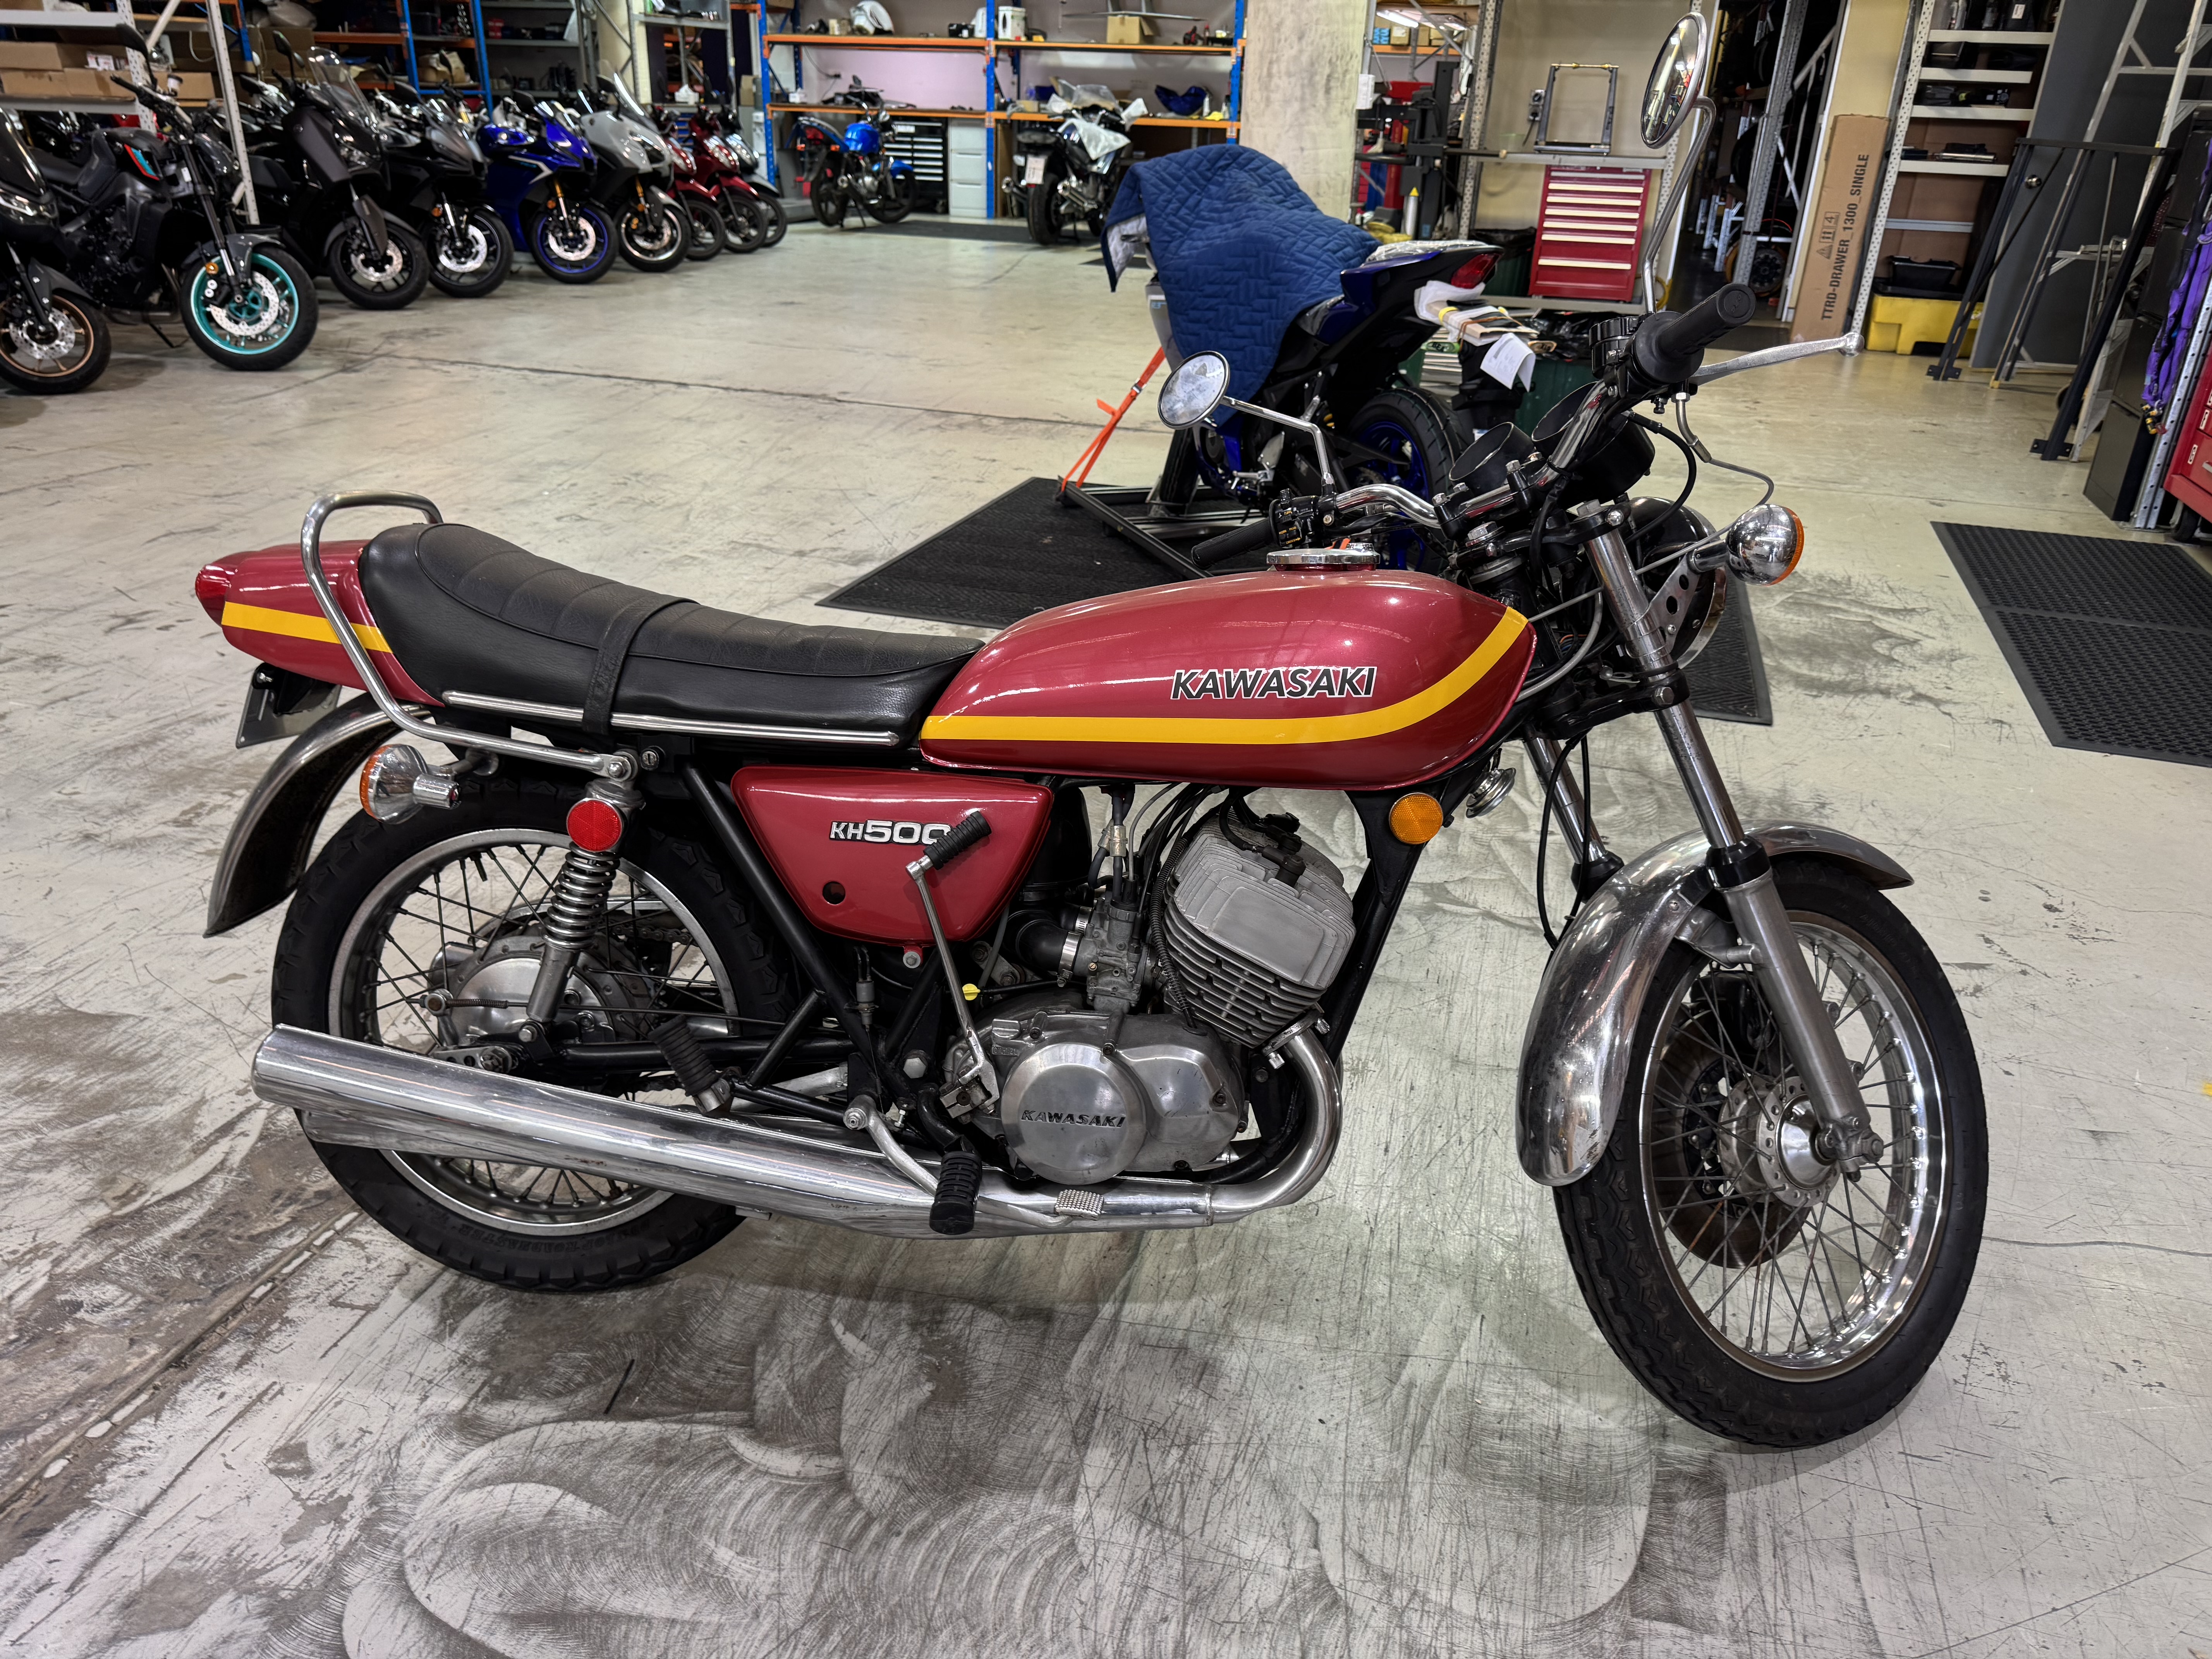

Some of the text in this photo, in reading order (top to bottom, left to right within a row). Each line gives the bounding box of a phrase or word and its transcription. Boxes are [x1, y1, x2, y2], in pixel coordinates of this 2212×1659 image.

[1822, 154, 1869, 321] TTRD-DRAWER_1300_SINGLE
[1170, 666, 1377, 699] KAWASAKI
[830, 819, 952, 845] KH500
[1021, 1110, 1126, 1128] KAWASAKI
